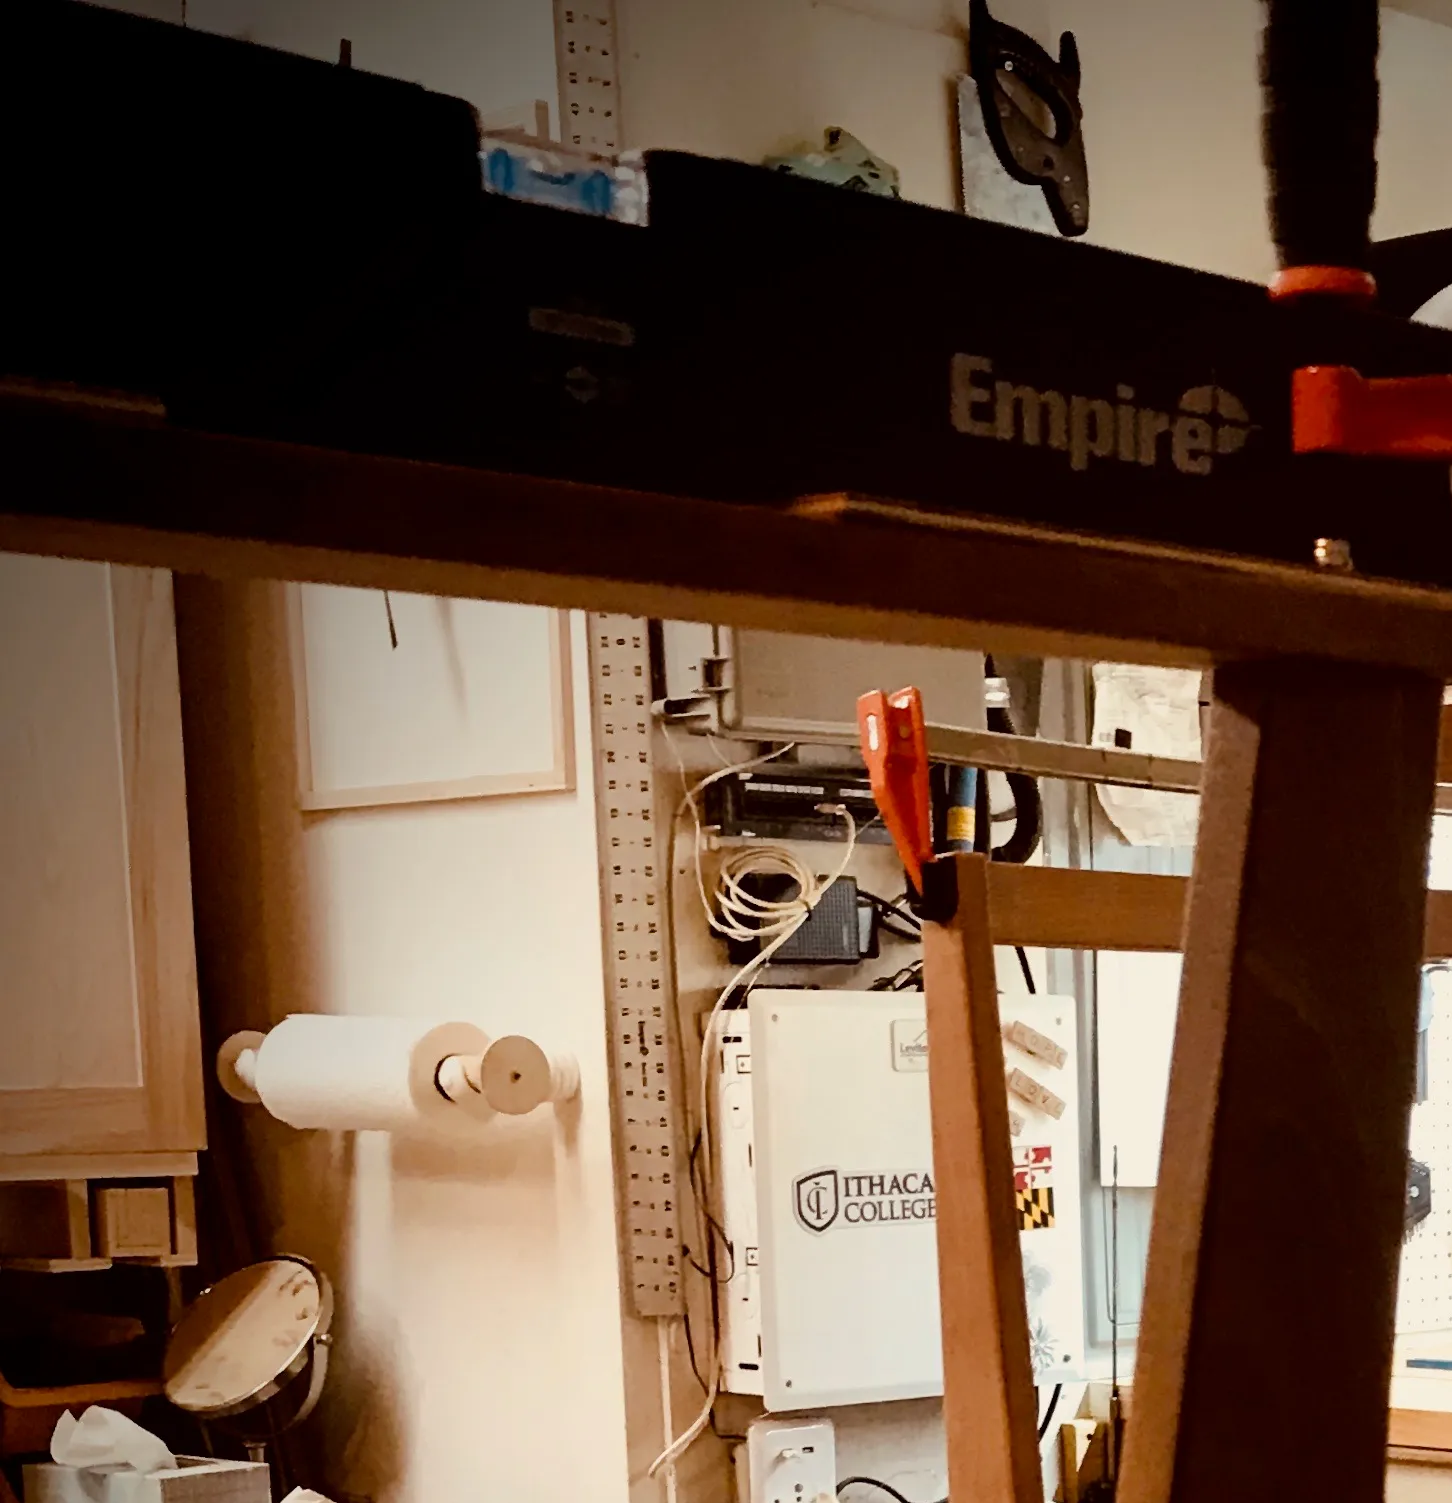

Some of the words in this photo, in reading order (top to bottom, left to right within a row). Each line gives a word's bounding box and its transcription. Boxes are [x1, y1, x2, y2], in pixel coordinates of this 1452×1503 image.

[950, 352, 1214, 476] Empire
[843, 1173, 935, 1197] ITHACA
[844, 1198, 937, 1223] COLLEGE
